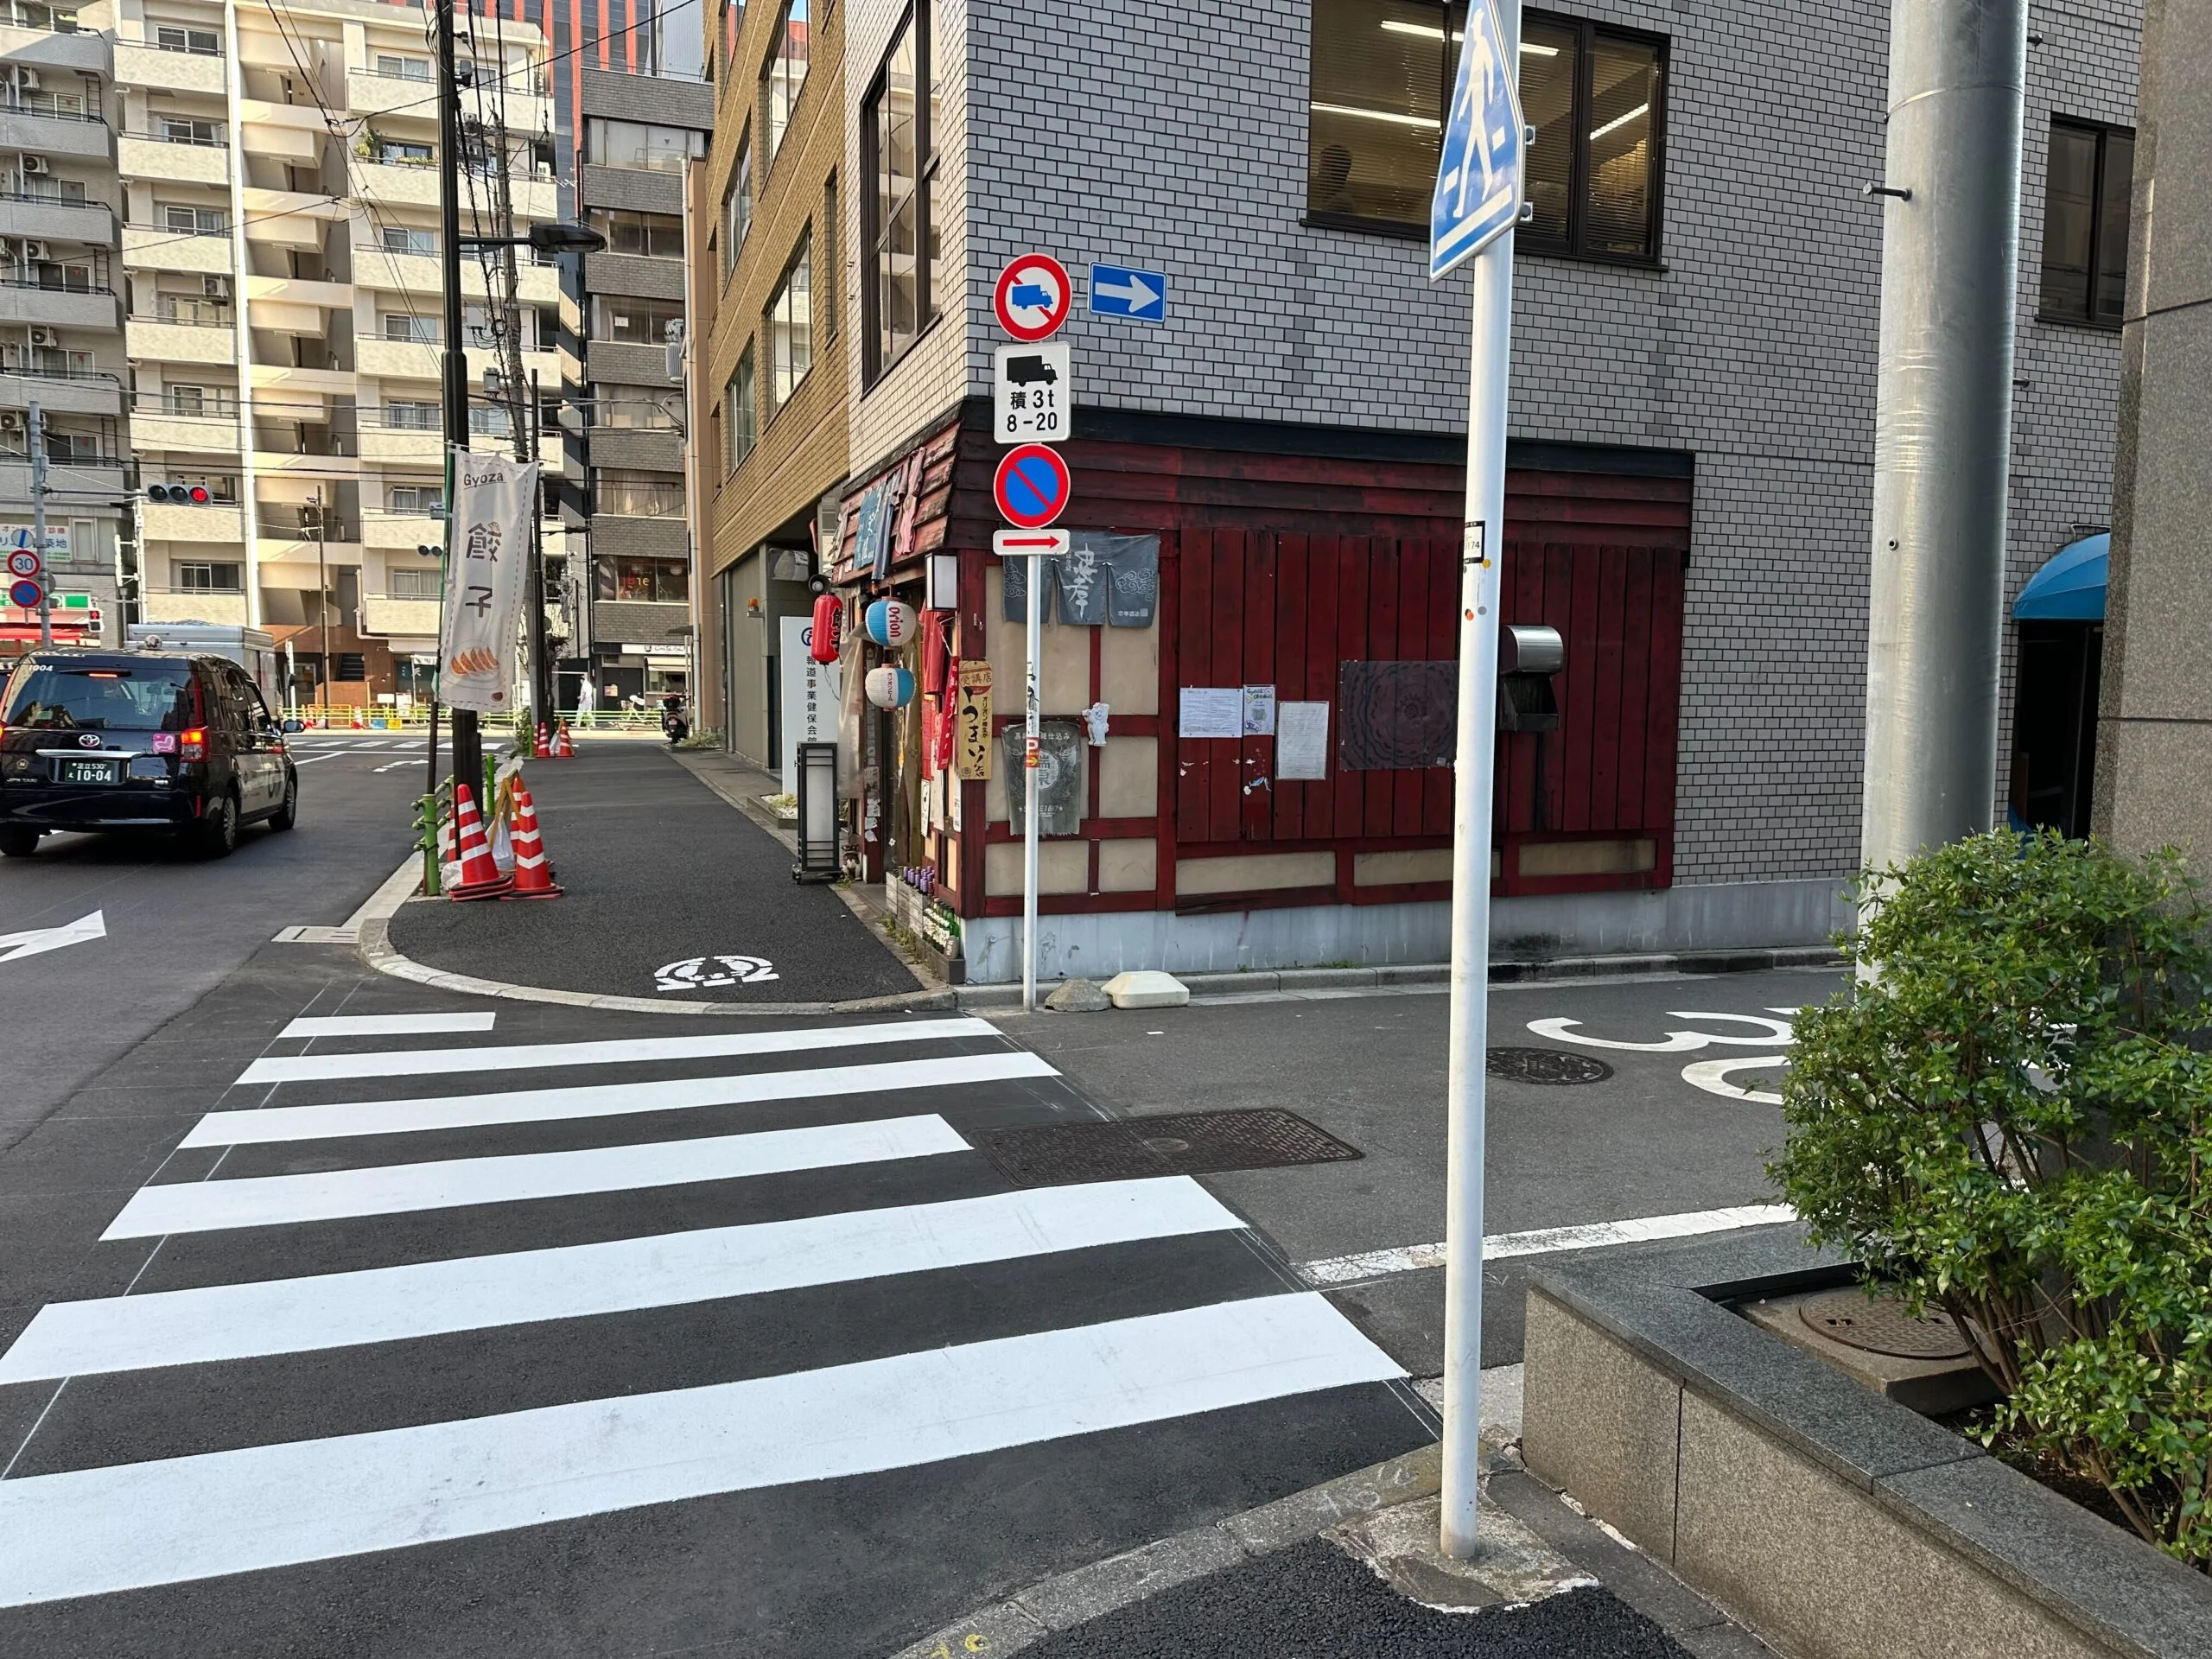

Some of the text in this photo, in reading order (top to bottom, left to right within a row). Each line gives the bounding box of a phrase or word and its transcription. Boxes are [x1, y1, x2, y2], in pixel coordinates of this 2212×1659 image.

[1007, 411, 1058, 433] 8-20
[463, 473, 505, 486] Gyoza
[15, 557, 34, 571] 30
[466, 521, 502, 618] 餃子
[888, 607, 904, 638] Orion
[77, 770, 112, 781] 10-04
